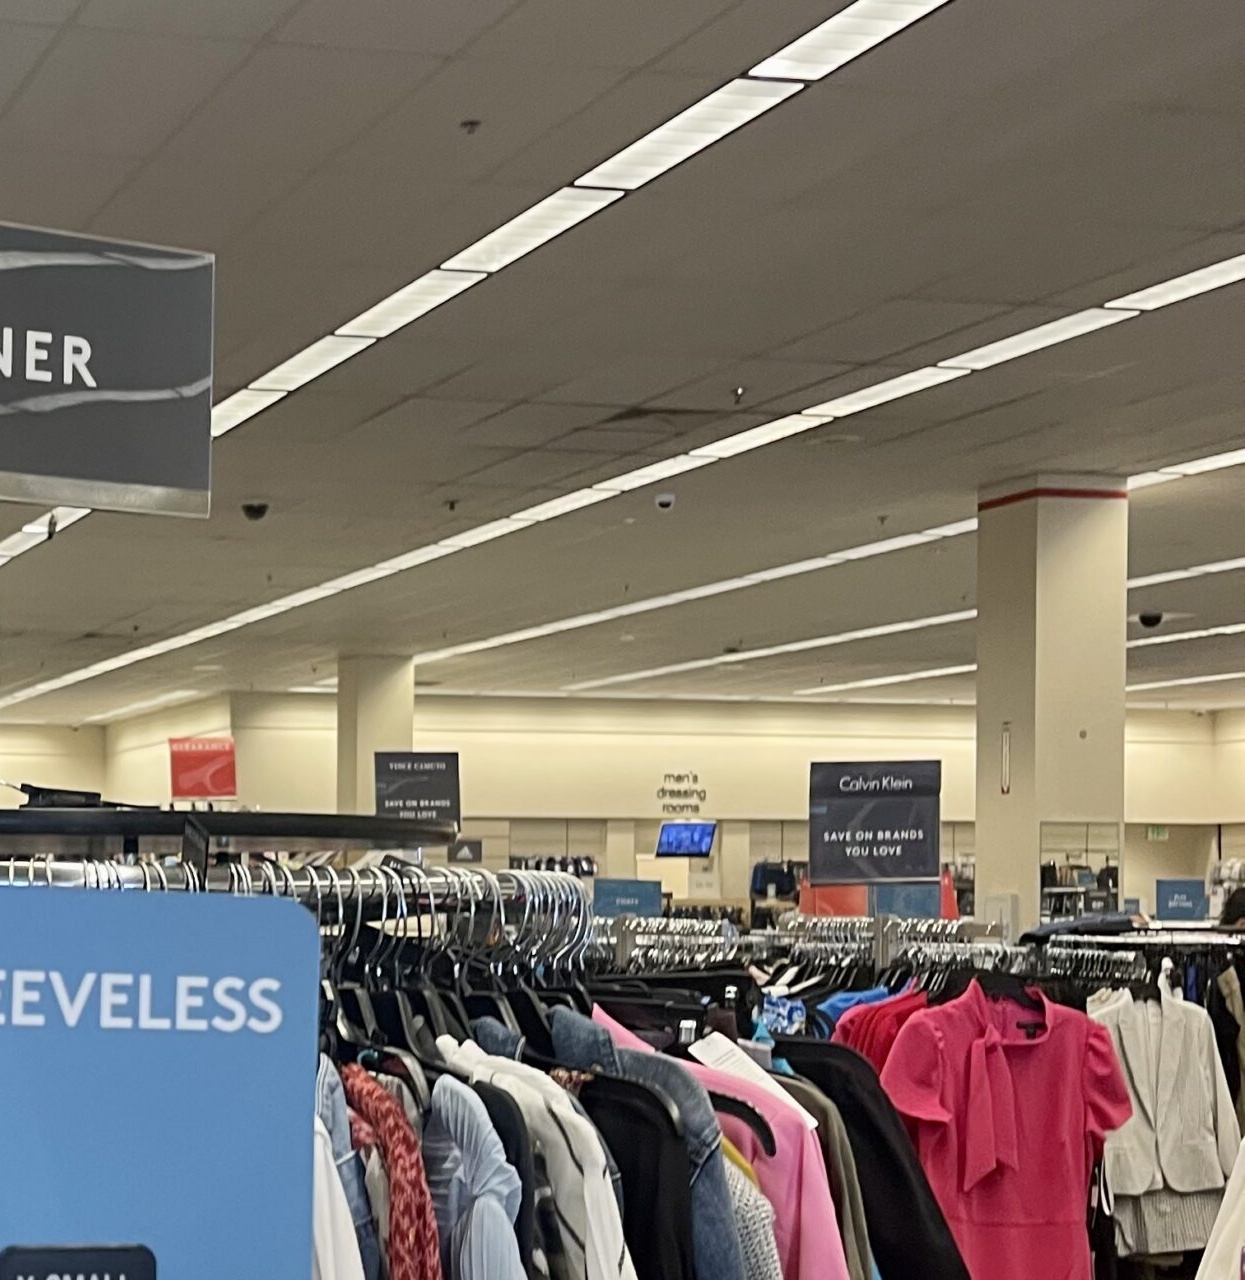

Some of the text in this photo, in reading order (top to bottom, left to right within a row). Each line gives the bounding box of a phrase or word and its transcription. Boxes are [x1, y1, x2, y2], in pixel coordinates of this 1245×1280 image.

[663, 770, 699, 785] men's
[839, 776, 913, 792] Calvin Klein
[657, 787, 707, 802] dressing
[385, 799, 404, 808] SAVE
[662, 803, 700, 815] rooms
[824, 829, 924, 842] SAVE ON BRANDS
[845, 845, 902, 857] YOU LOVE
